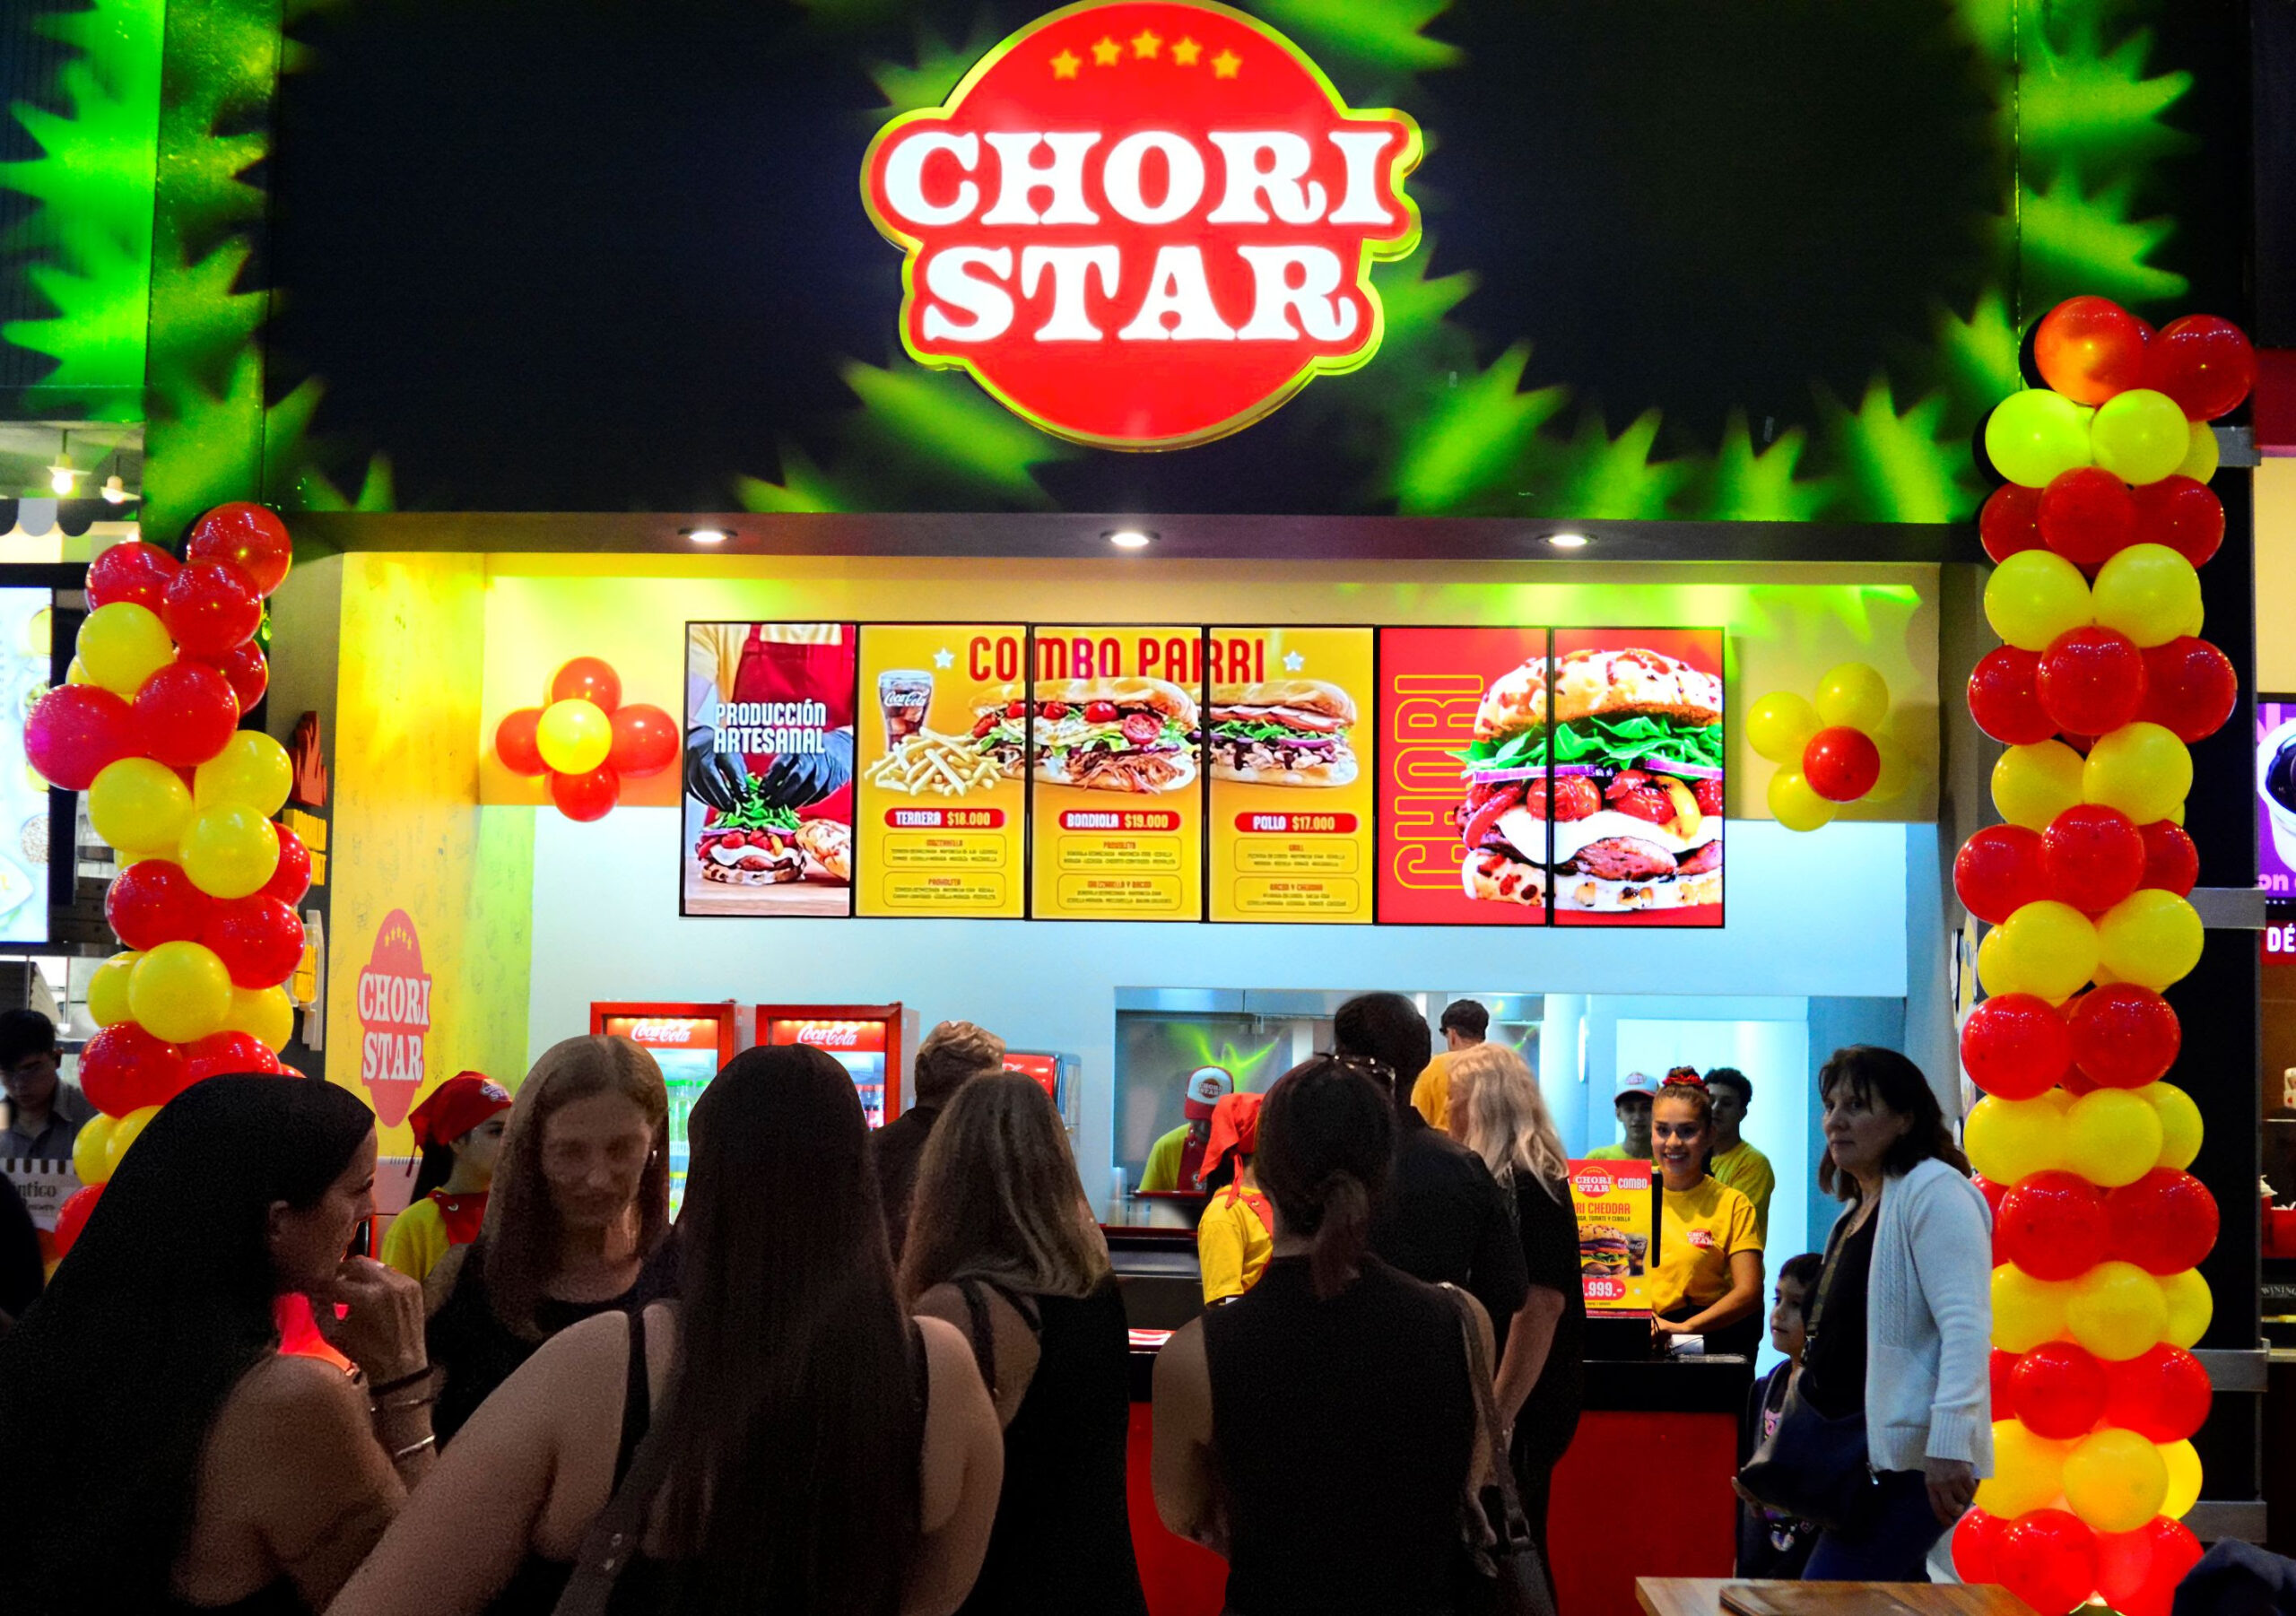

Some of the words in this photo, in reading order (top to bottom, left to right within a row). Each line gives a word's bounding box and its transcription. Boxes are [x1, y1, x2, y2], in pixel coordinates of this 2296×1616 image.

[884, 131, 1395, 226] CHORI
[923, 245, 1359, 342] STAR
[970, 637, 1120, 682] COMBO
[1138, 638, 1264, 683] PARRI
[716, 699, 826, 726] PRODUCCIÓN
[713, 727, 826, 753] ARTESANAL
[1394, 675, 1484, 889] CHORI
[895, 811, 942, 825] TERNERA
[947, 812, 991, 826] $18.000
[1066, 813, 1119, 828] BONDIOLA
[1125, 814, 1169, 829] $19.000
[1252, 815, 1287, 830] POLLO
[1292, 816, 1335, 830] $17.000
[359, 972, 430, 1025] CHORI
[363, 1031, 424, 1082] STAR
[18, 1182, 57, 1198] ntico
[1575, 1176, 1612, 1184] CHORI
[1618, 1177, 1648, 1189] COMBO
[1588, 1203, 1631, 1215] CHEDDAR
